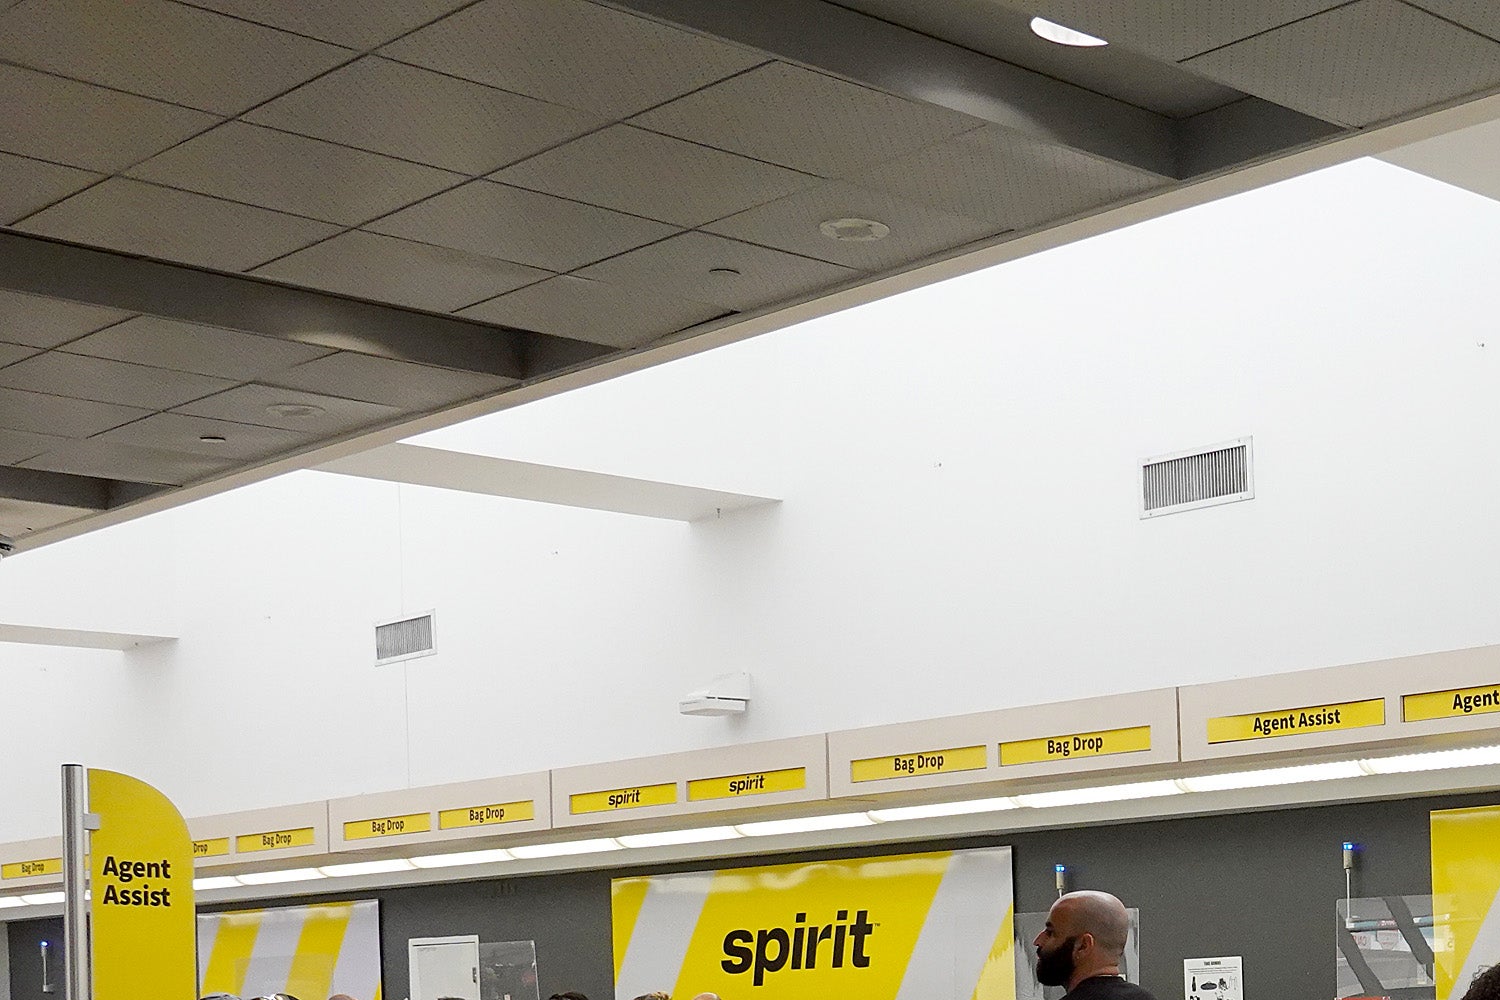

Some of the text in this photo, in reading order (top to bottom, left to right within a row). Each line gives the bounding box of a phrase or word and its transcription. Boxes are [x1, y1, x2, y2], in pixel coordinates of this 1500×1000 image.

[1452, 690, 1500, 713] Agent
[1252, 708, 1341, 736] Agent Assist
[1047, 735, 1104, 757] Bag Drop
[893, 754, 945, 774] Bag Drop
[728, 773, 765, 795] spirit
[607, 789, 641, 809] spirit
[469, 805, 506, 823] Bag Drop
[371, 817, 406, 834] Bag Drop
[262, 832, 292, 849] Bag Drop
[21, 861, 45, 874] Bag Drop
[102, 856, 171, 883] Agent
[102, 883, 171, 907] Assist
[720, 910, 873, 987] spirit
